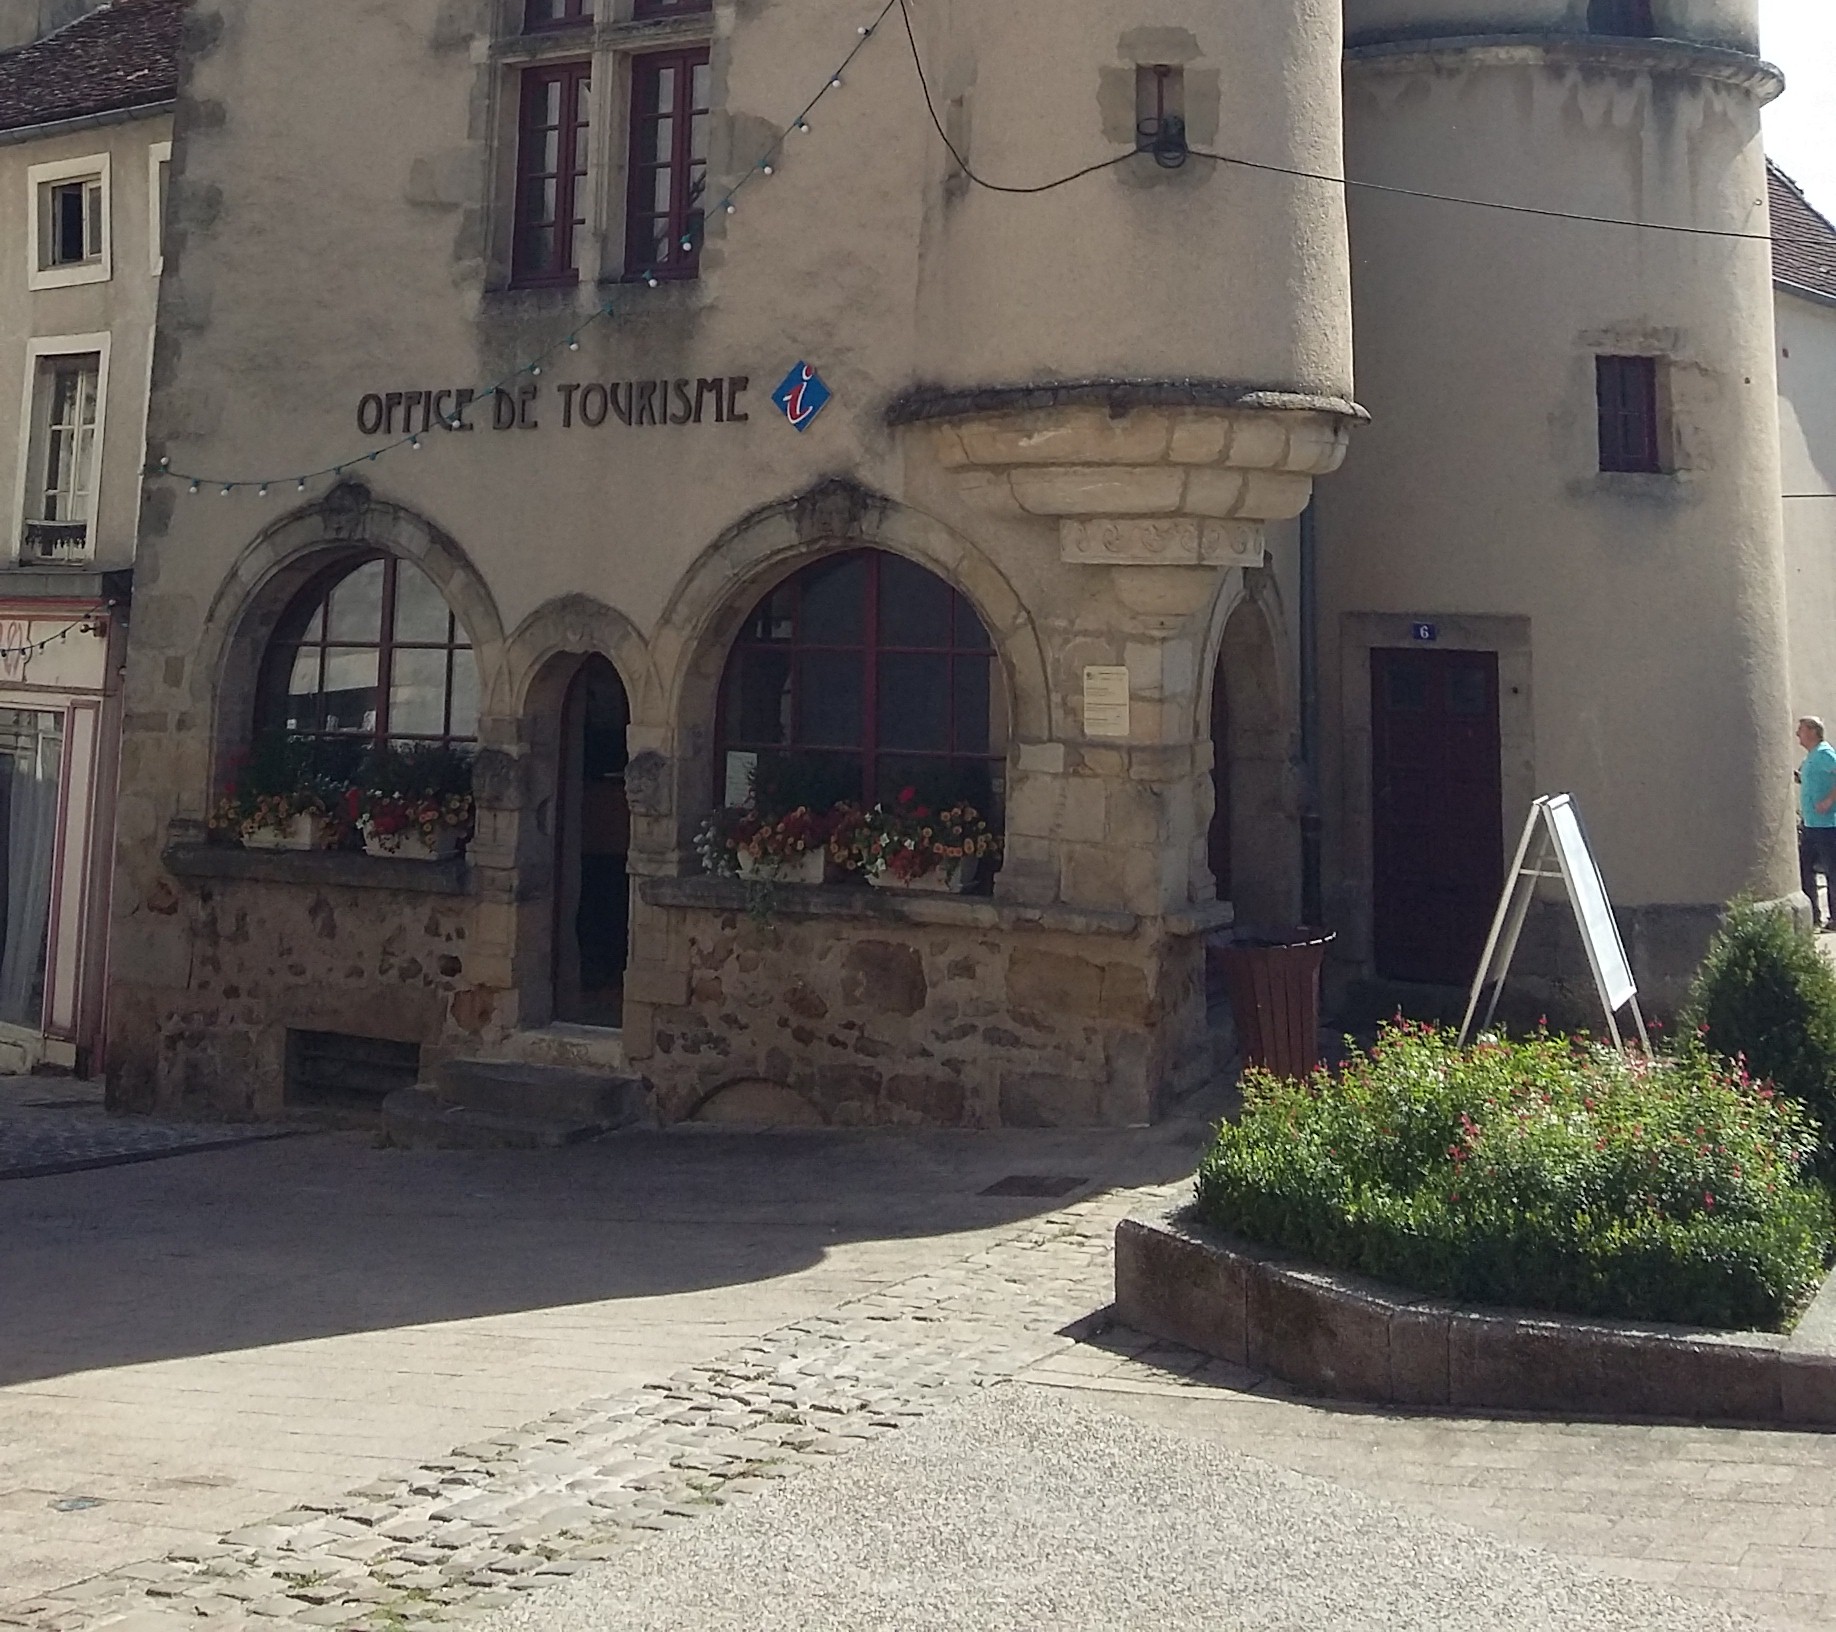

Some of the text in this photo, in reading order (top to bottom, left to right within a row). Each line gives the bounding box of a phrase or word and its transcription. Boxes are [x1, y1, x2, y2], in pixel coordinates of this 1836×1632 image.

[357, 375, 749, 435] OFFICE DE TOURISME
[1420, 625, 1430, 639] 6
